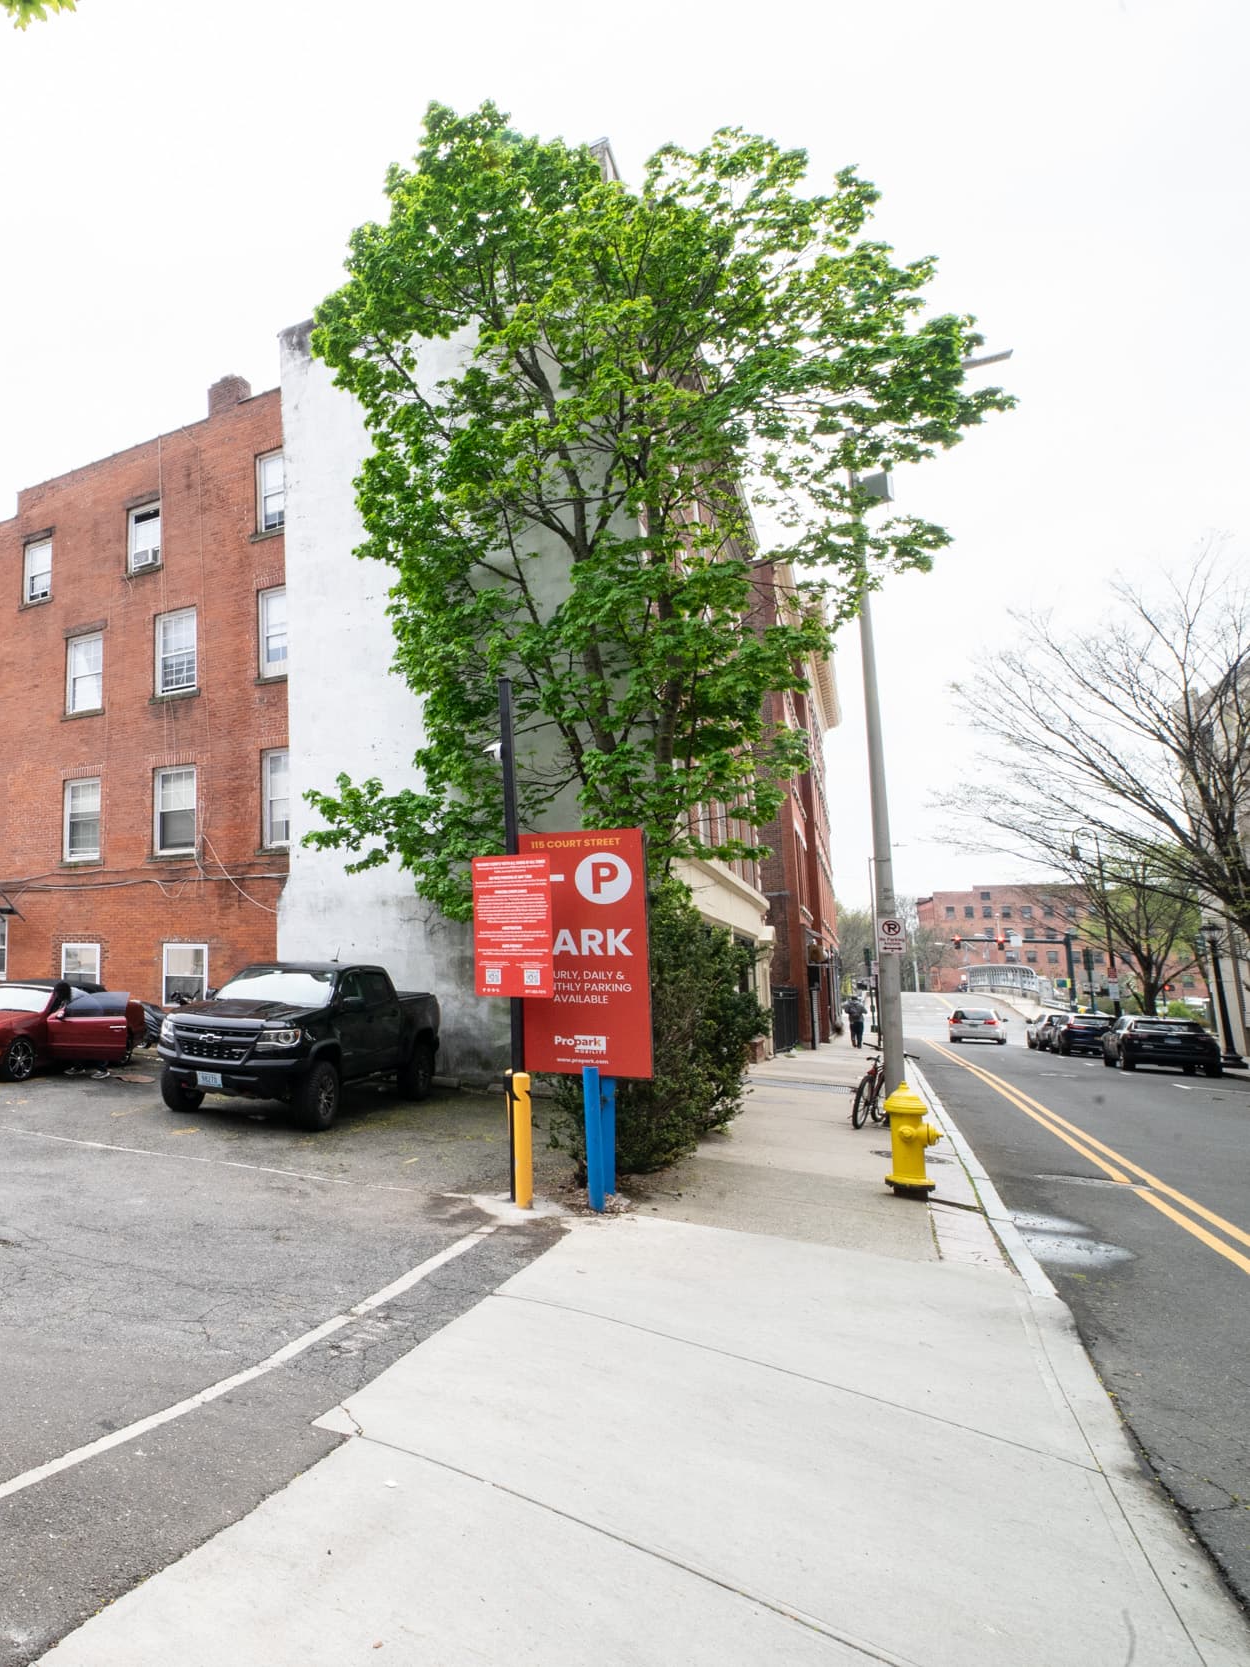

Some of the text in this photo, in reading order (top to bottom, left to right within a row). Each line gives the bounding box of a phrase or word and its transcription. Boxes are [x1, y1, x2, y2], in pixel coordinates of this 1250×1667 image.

[531, 837, 622, 849] 115 COURT STREET
[591, 862, 619, 895] P
[552, 928, 634, 956] ARK
[553, 970, 625, 980] URLY, DAILY &
[553, 982, 632, 992] THLY PARKING
[553, 993, 609, 1004] AVAILABLE
[554, 1035, 602, 1049] Propark
